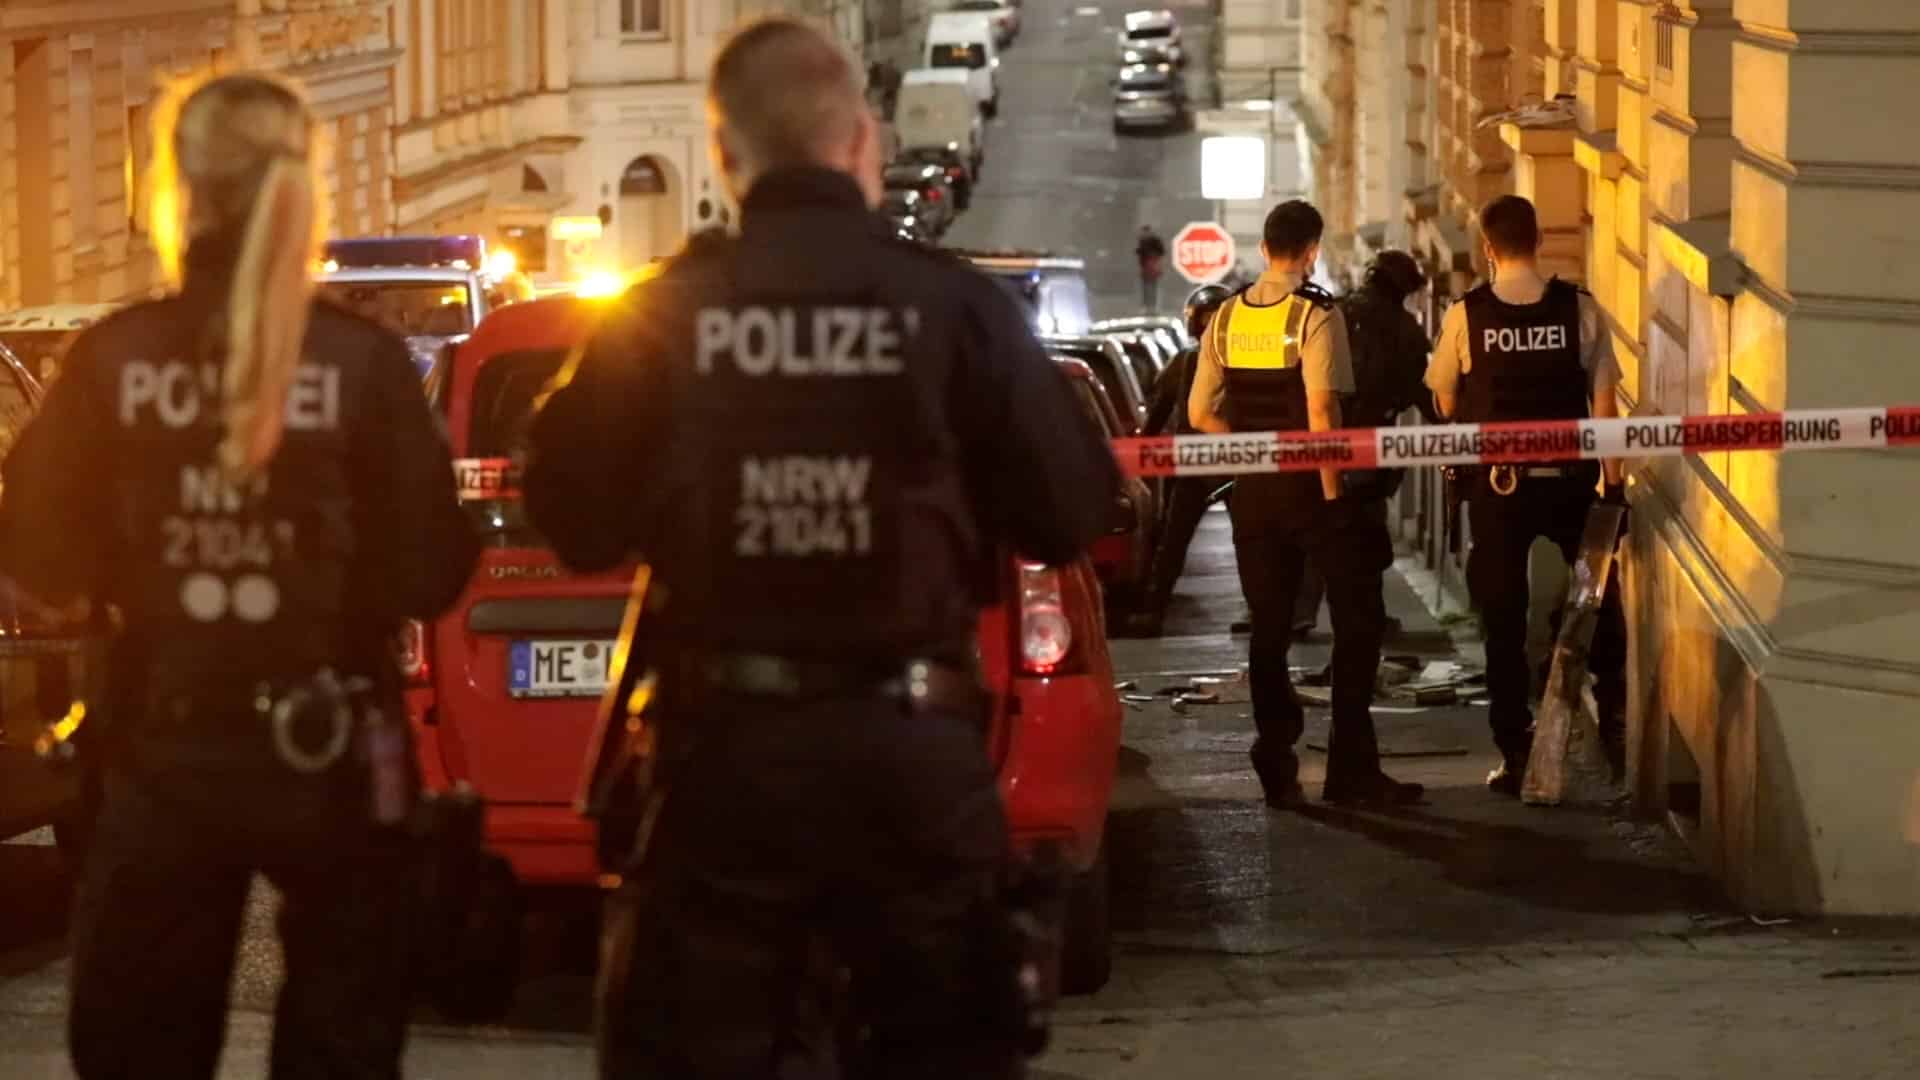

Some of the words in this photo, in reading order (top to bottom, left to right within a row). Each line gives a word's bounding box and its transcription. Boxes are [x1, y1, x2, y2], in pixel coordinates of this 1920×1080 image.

[1179, 240, 1228, 265] STOP
[1483, 324, 1567, 353] POLIZEI
[119, 360, 341, 430] POEI
[1381, 428, 1596, 459] POLIZEIABSPERRUNG
[1625, 418, 1841, 450] POLIZEIABSPERRUNG
[1138, 435, 1355, 468] POLIZEIABSPERRUNG
[741, 455, 873, 502] NRW
[735, 507, 873, 556] 21041
[535, 647, 576, 683] ME
